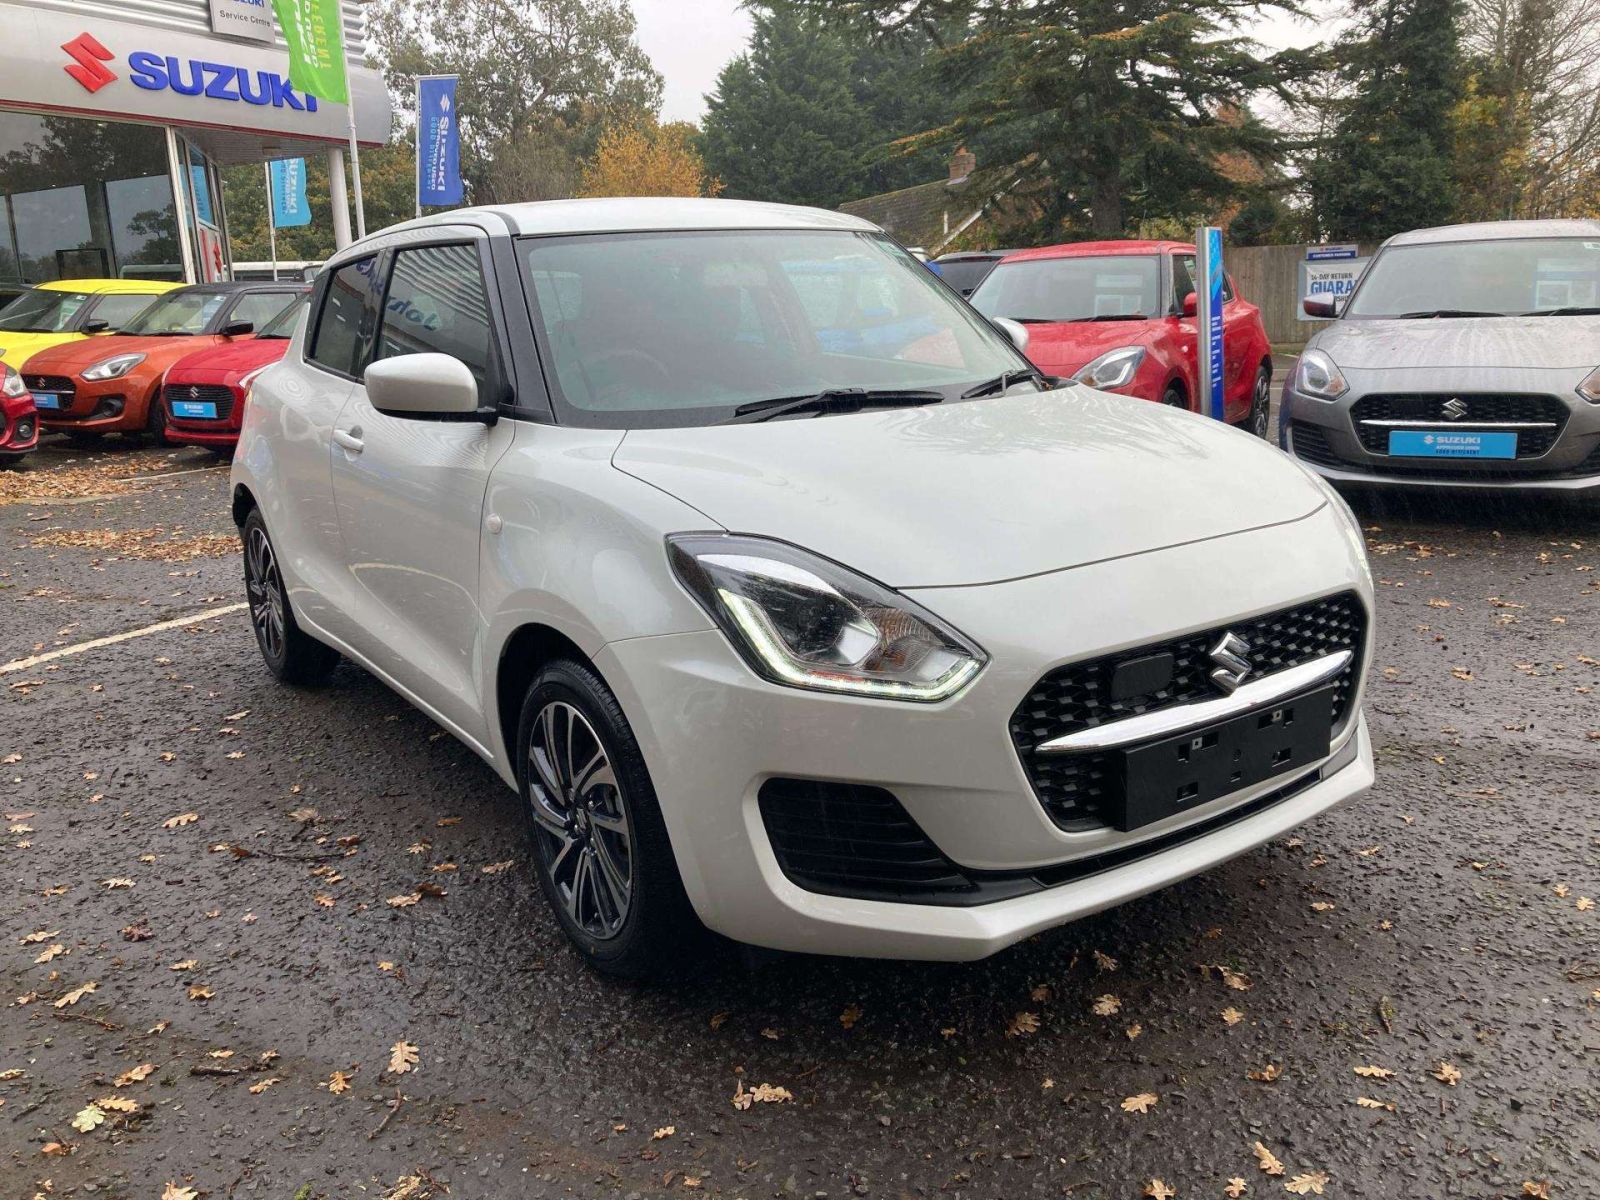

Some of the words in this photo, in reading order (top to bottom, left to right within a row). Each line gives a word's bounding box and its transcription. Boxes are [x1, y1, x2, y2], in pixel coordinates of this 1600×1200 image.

[220, 10, 249, 22] Service
[250, 15, 271, 27] Centre
[128, 51, 318, 112] SUZUKI
[437, 116, 449, 191] SUZUKI
[1310, 280, 1357, 295] GUARA
